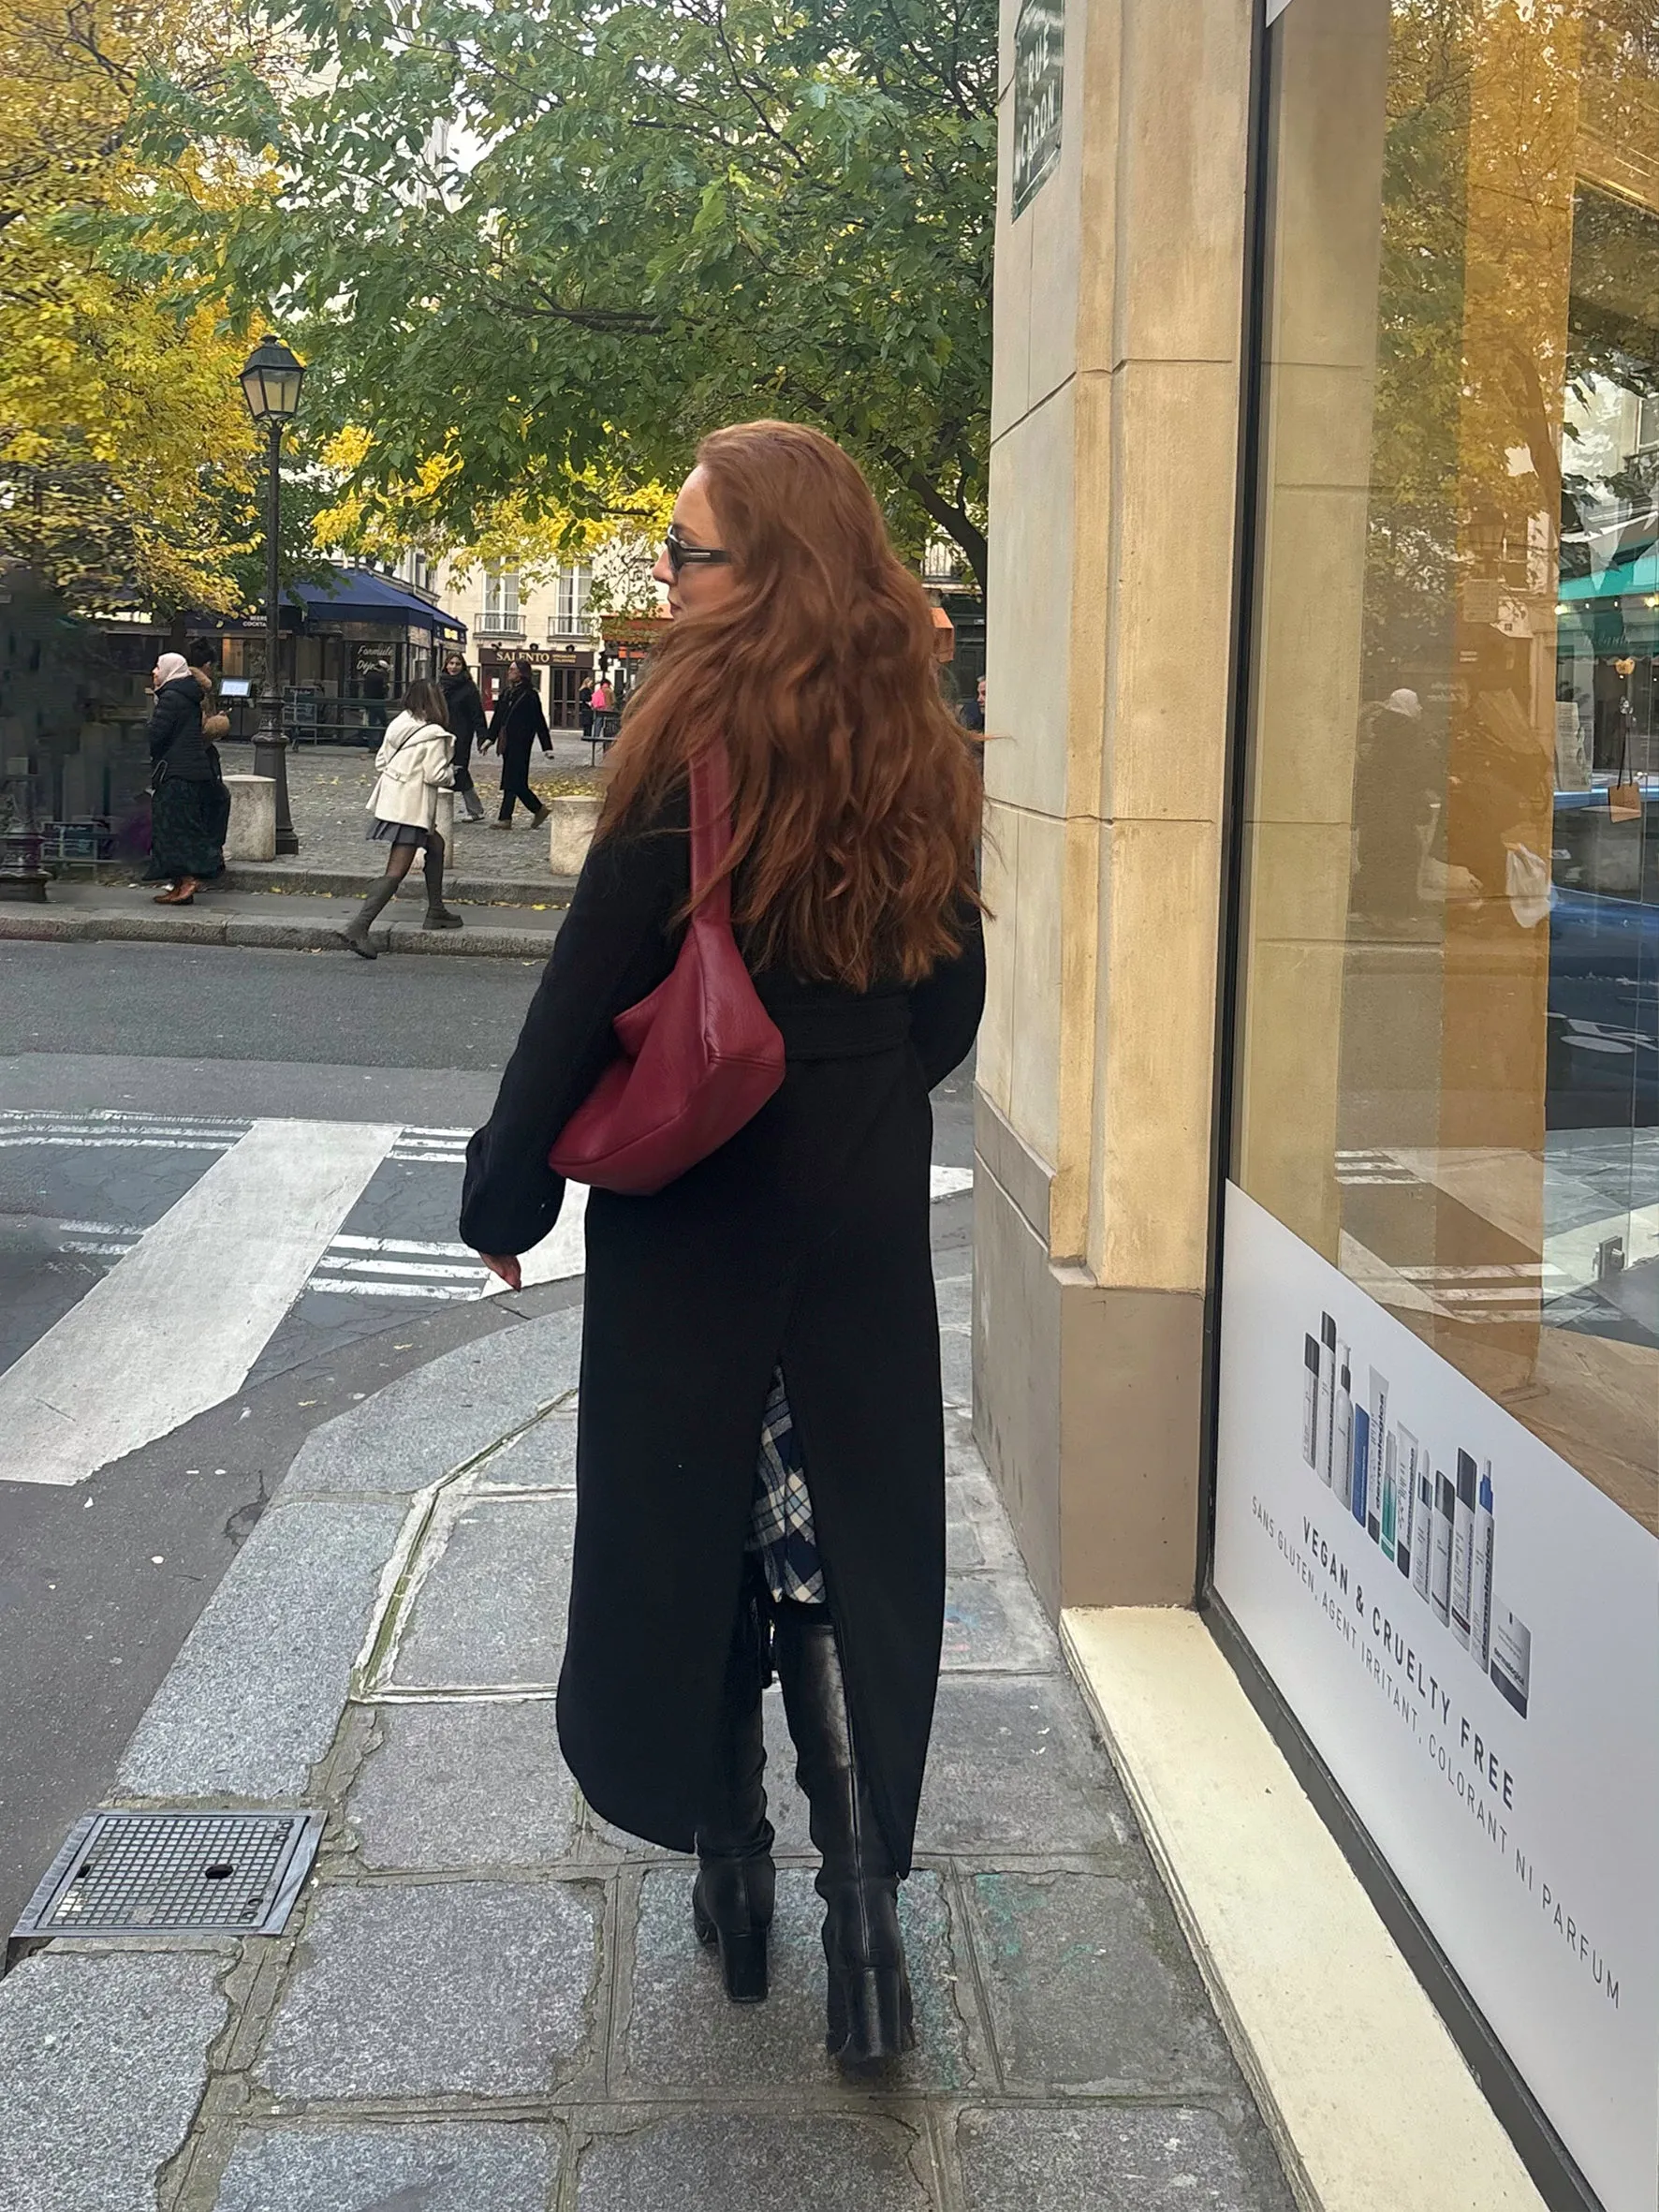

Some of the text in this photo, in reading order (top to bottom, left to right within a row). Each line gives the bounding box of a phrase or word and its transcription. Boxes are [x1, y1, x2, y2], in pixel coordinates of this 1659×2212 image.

[1028, 22, 1050, 96] RUE
[1021, 79, 1055, 168] CARON
[496, 651, 551, 663] SALENTO
[1375, 1393, 1385, 1510] dermalogica
[1481, 1526, 1492, 1660] dermalogica
[1303, 1516, 1348, 1596] VEGAN
[1356, 1585, 1364, 1618] &
[1373, 1606, 1451, 1726] CRUELTY
[1461, 1717, 1514, 1811] FREE
[1252, 1496, 1275, 1539] SANS
[1321, 1591, 1357, 1649] AGENT
[1428, 1733, 1507, 1854] COLORANT
[1516, 1848, 1533, 1891] NI
[1542, 1883, 1620, 2010] PARFUM
